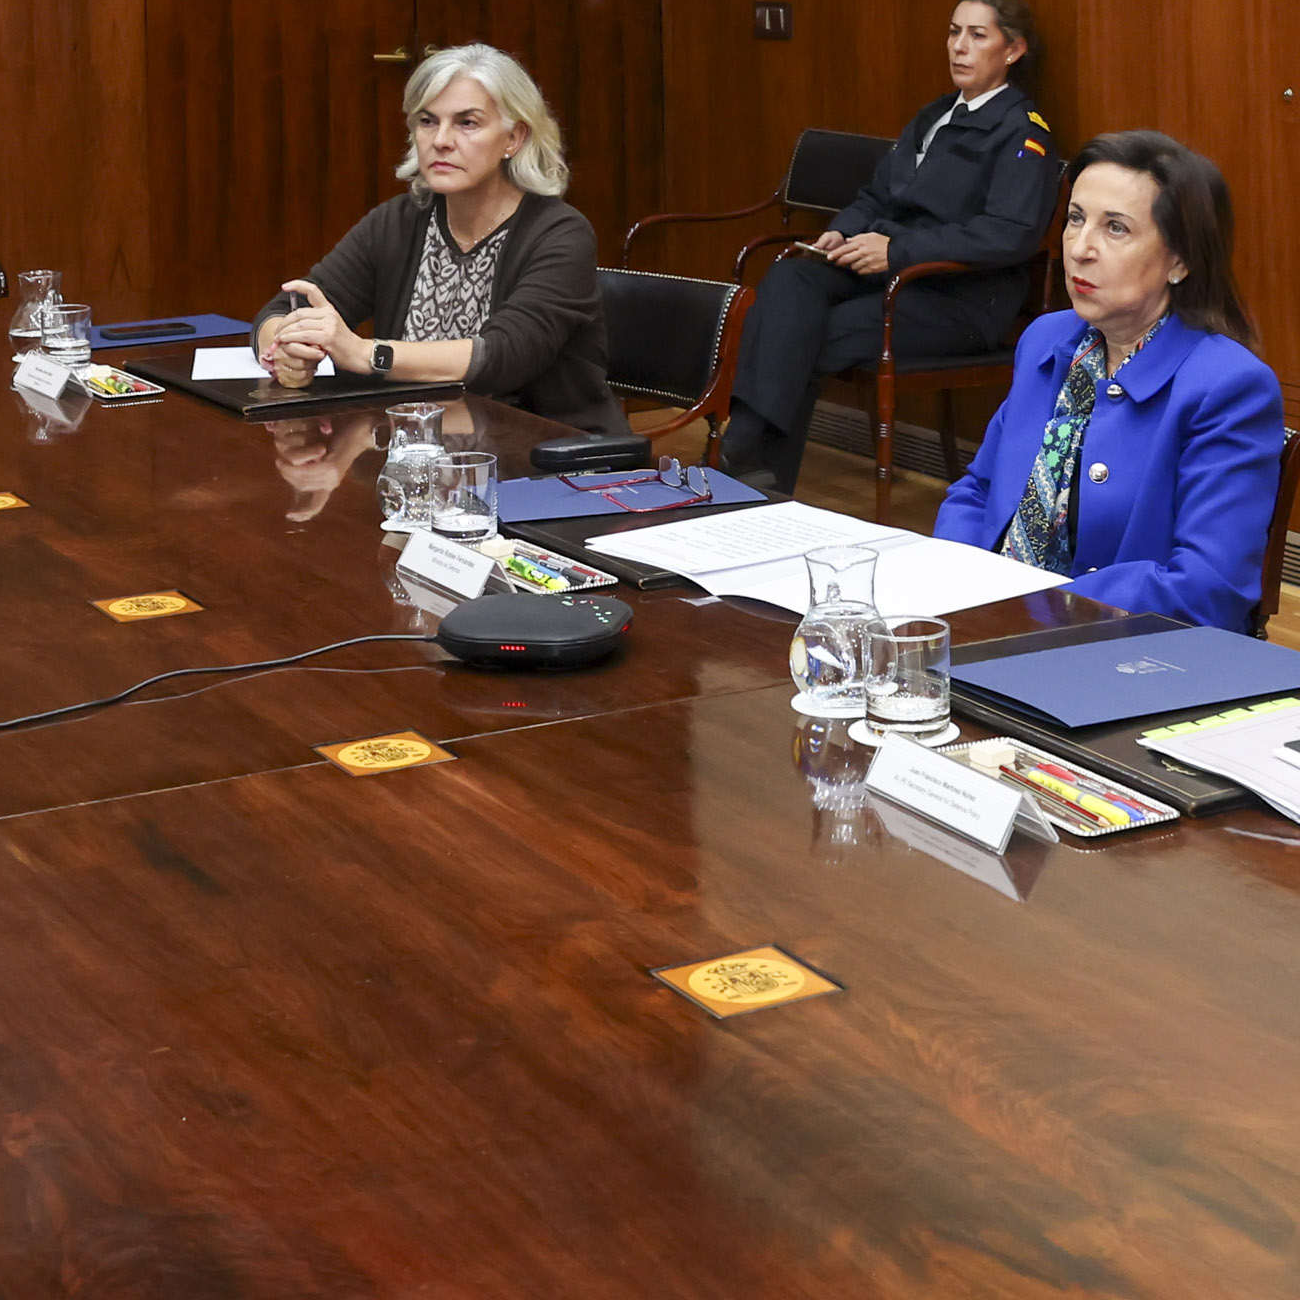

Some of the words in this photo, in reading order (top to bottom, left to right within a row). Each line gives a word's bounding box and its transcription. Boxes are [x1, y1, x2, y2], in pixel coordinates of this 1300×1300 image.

[909, 767, 921, 776] Juan
[921, 771, 942, 786] Francisco
[926, 789, 944, 802] General
